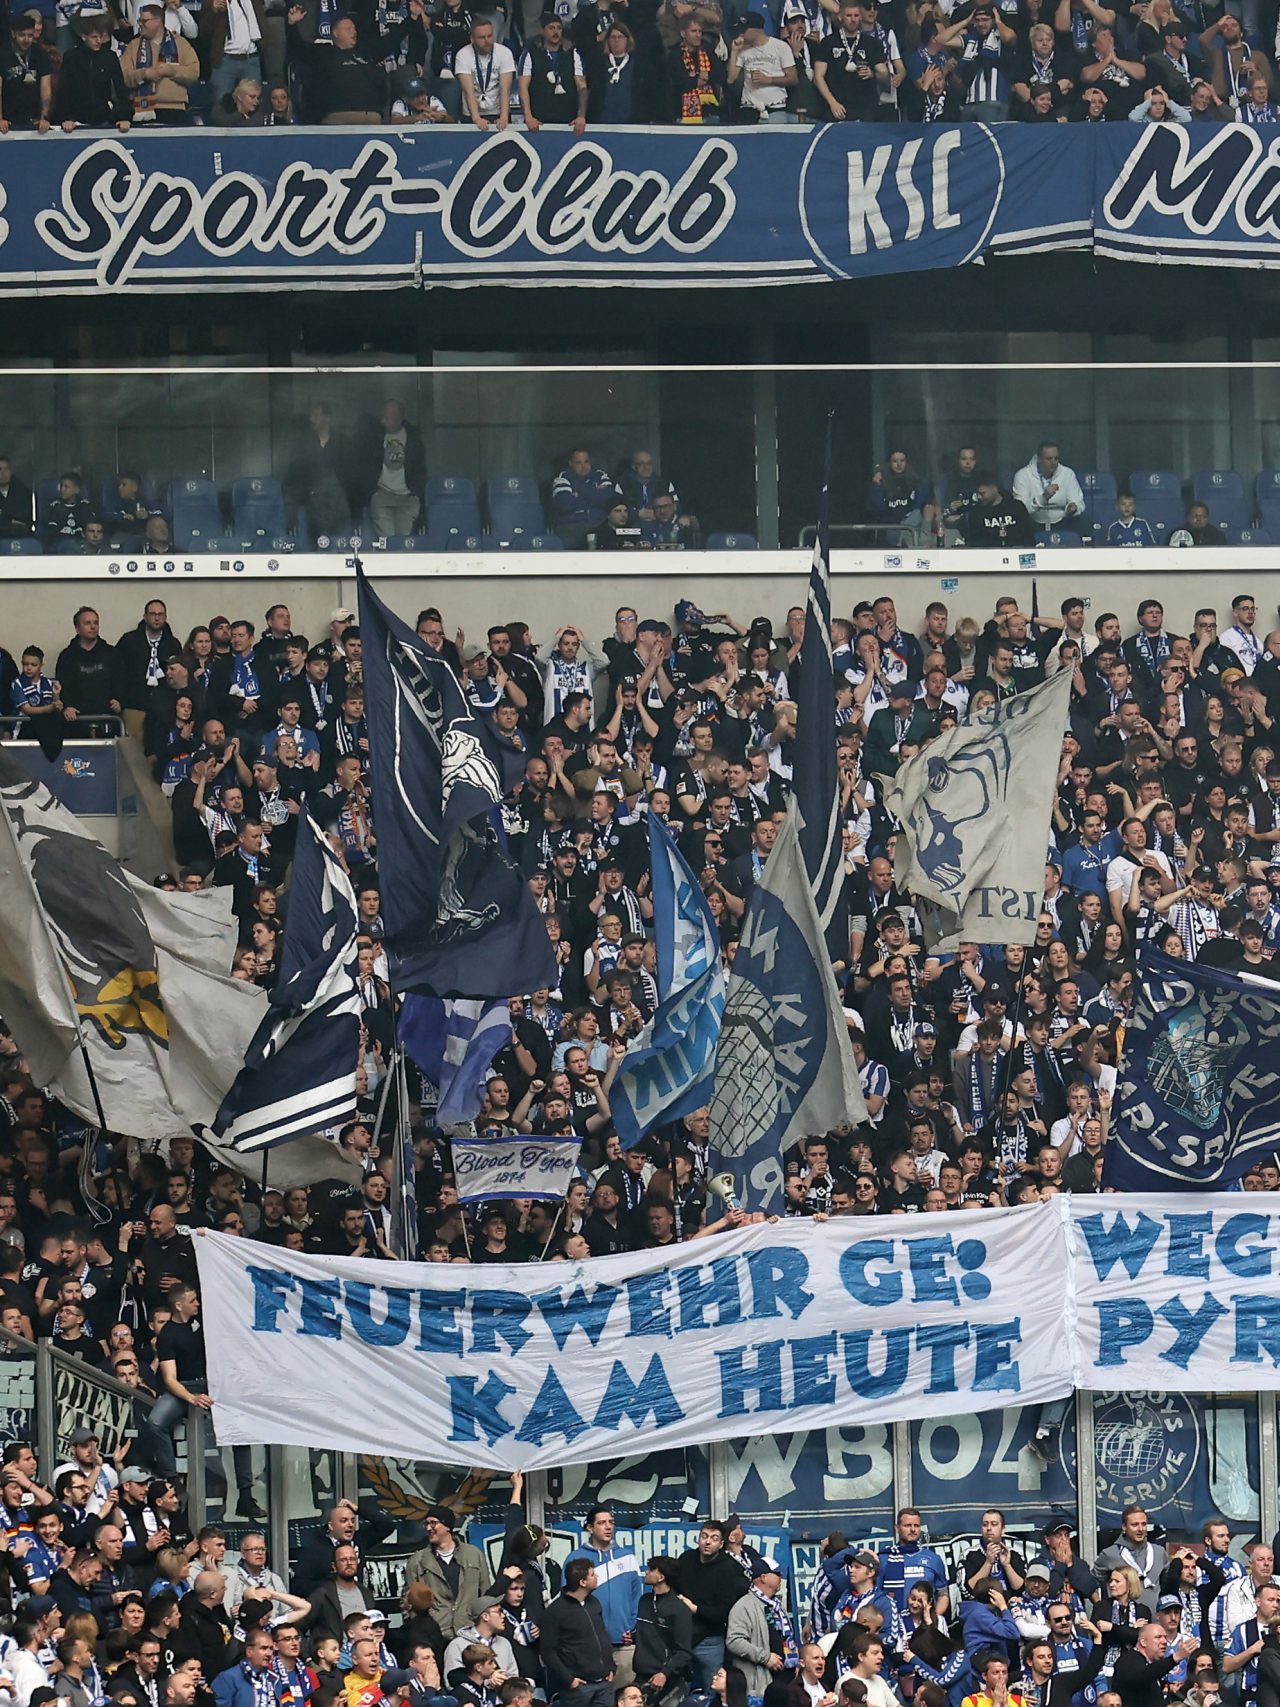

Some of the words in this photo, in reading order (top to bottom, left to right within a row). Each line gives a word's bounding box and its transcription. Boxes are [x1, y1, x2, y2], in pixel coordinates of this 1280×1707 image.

[35, 130, 738, 288] Sport-Club
[847, 129, 964, 256] KSC
[455, 1152, 515, 1174] Blood
[521, 1146, 574, 1173] Type
[246, 1246, 815, 1358] FEUERWEHR
[839, 1233, 993, 1307] GE:
[446, 1352, 686, 1447] KAM
[714, 1316, 1023, 1418] HEUTE
